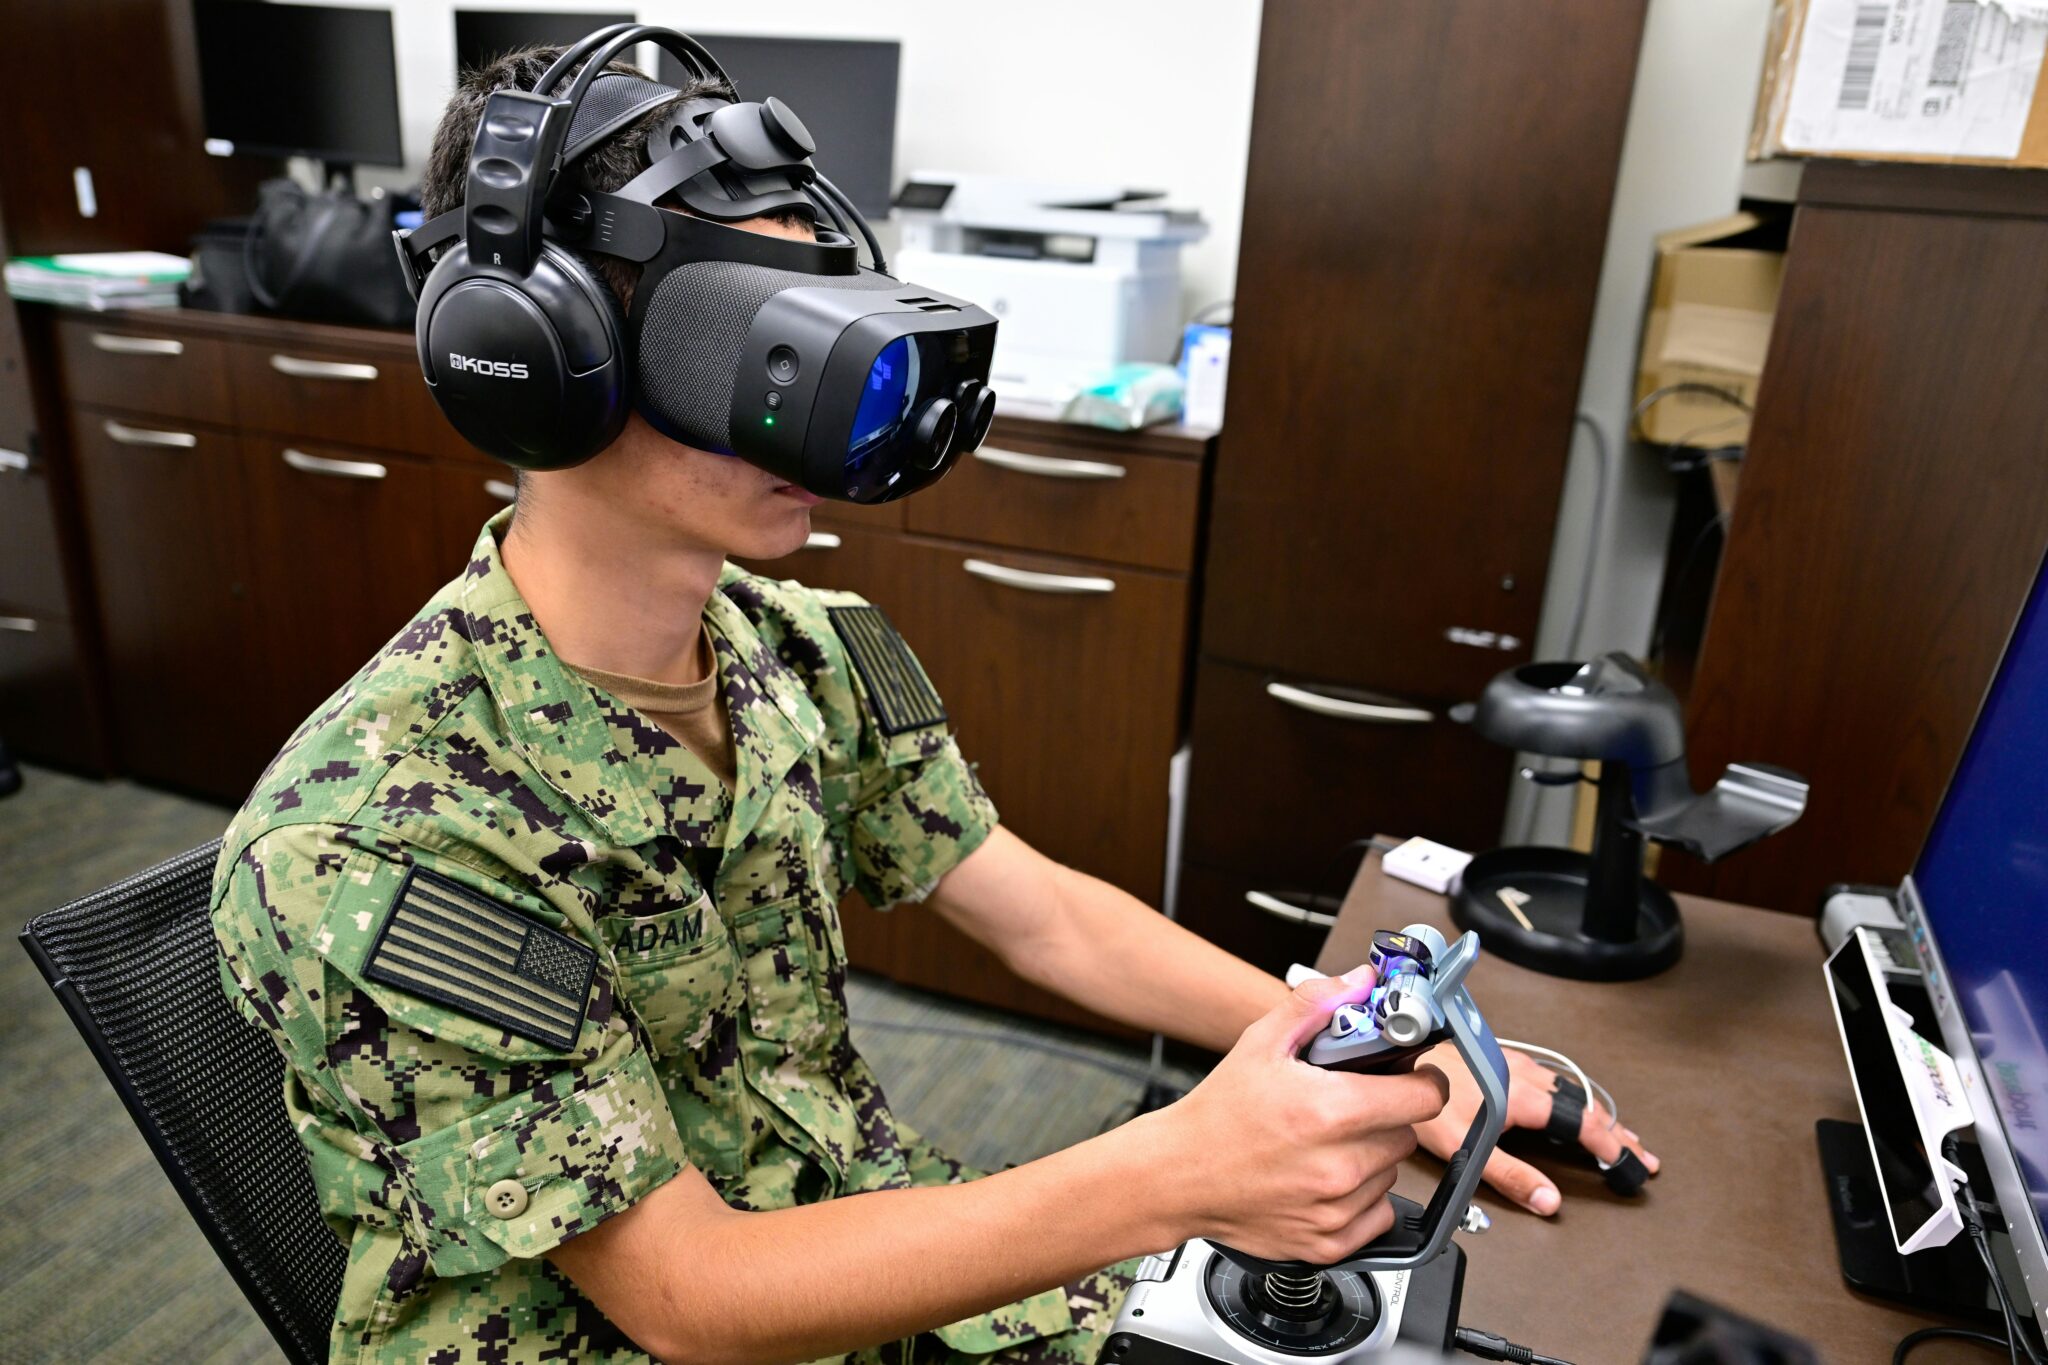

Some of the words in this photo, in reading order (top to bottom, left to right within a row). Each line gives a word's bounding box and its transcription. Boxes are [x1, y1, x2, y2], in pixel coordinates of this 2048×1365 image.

[493, 252, 502, 265] R
[461, 355, 529, 379] KOSS
[612, 907, 704, 956] ADAM
[1390, 1270, 1405, 1306] ONTROL
